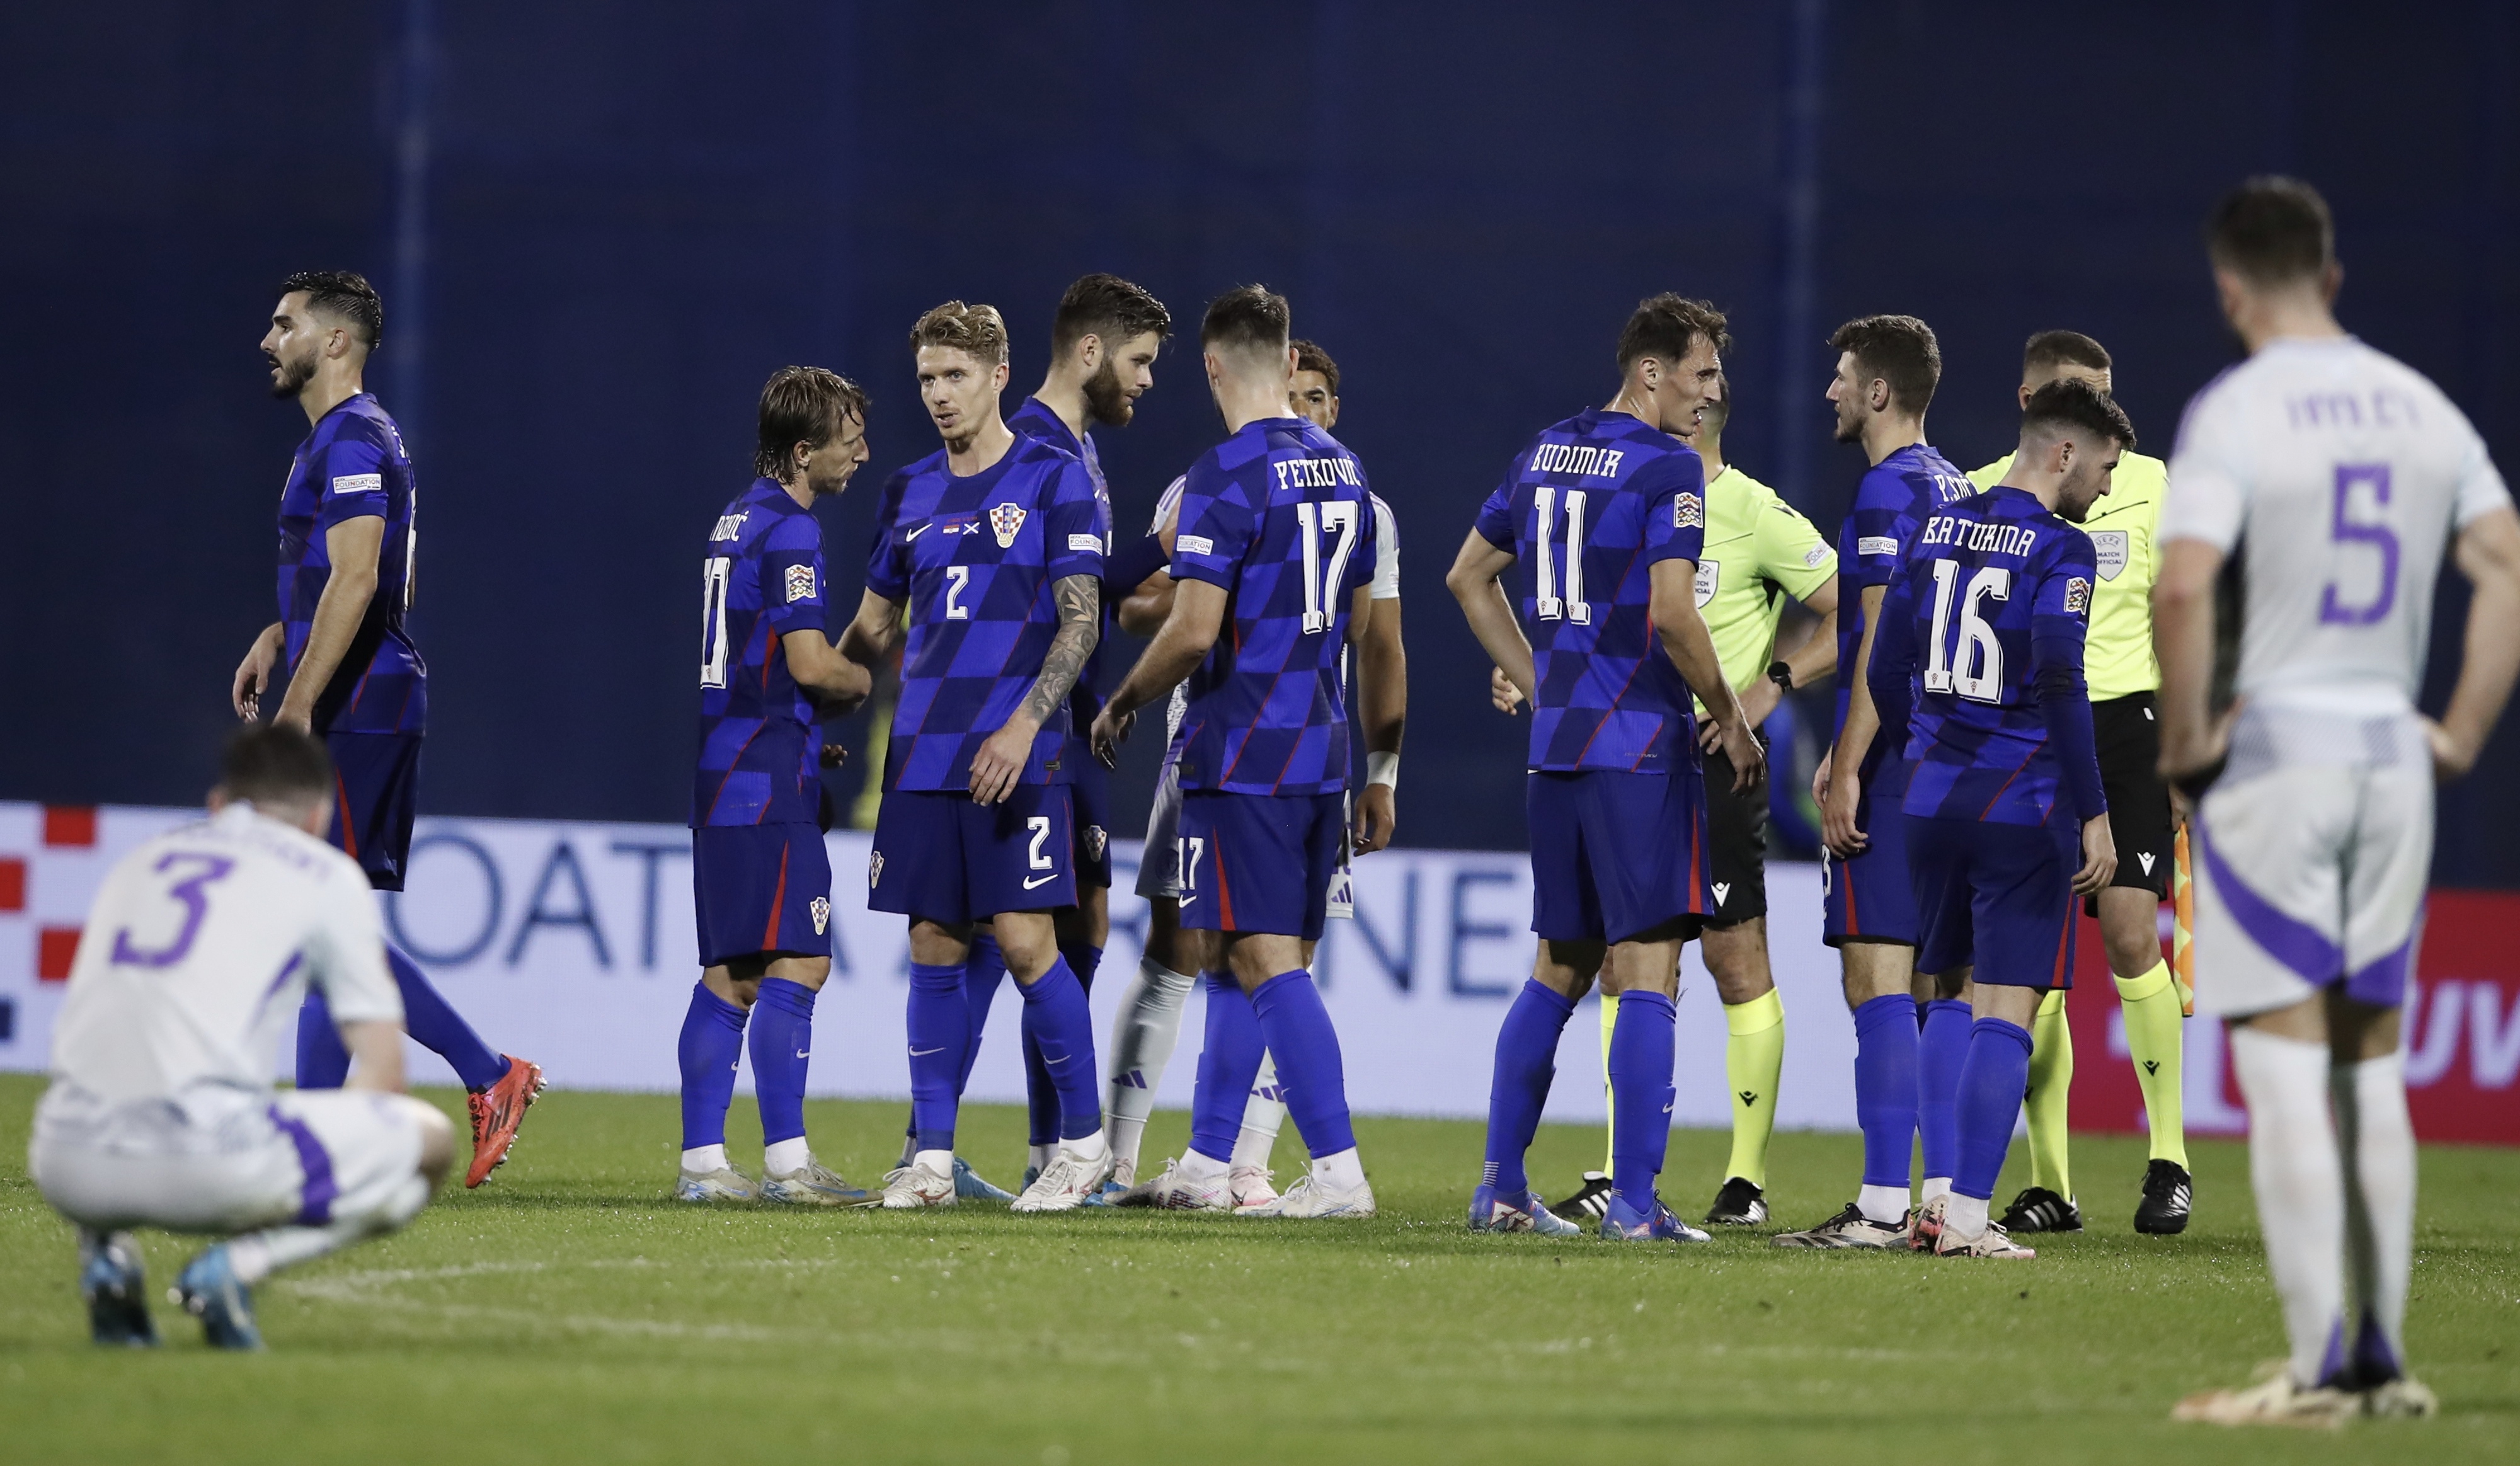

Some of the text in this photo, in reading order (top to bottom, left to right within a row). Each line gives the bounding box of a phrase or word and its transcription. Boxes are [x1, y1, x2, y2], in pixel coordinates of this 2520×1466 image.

[335, 478, 381, 490] FOUNDATION
[1531, 443, 1624, 478] BUDIMIR
[1535, 486, 1591, 626] 11
[1922, 516, 2036, 558] BATURINA
[2096, 537, 2119, 546] UEFA
[2318, 461, 2402, 626] 5
[946, 566, 969, 619] 2
[1297, 500, 1358, 635] 17
[1923, 558, 2010, 705] 16
[1027, 816, 1053, 870] 2
[1177, 836, 1204, 890] 17
[109, 850, 237, 971] 3
